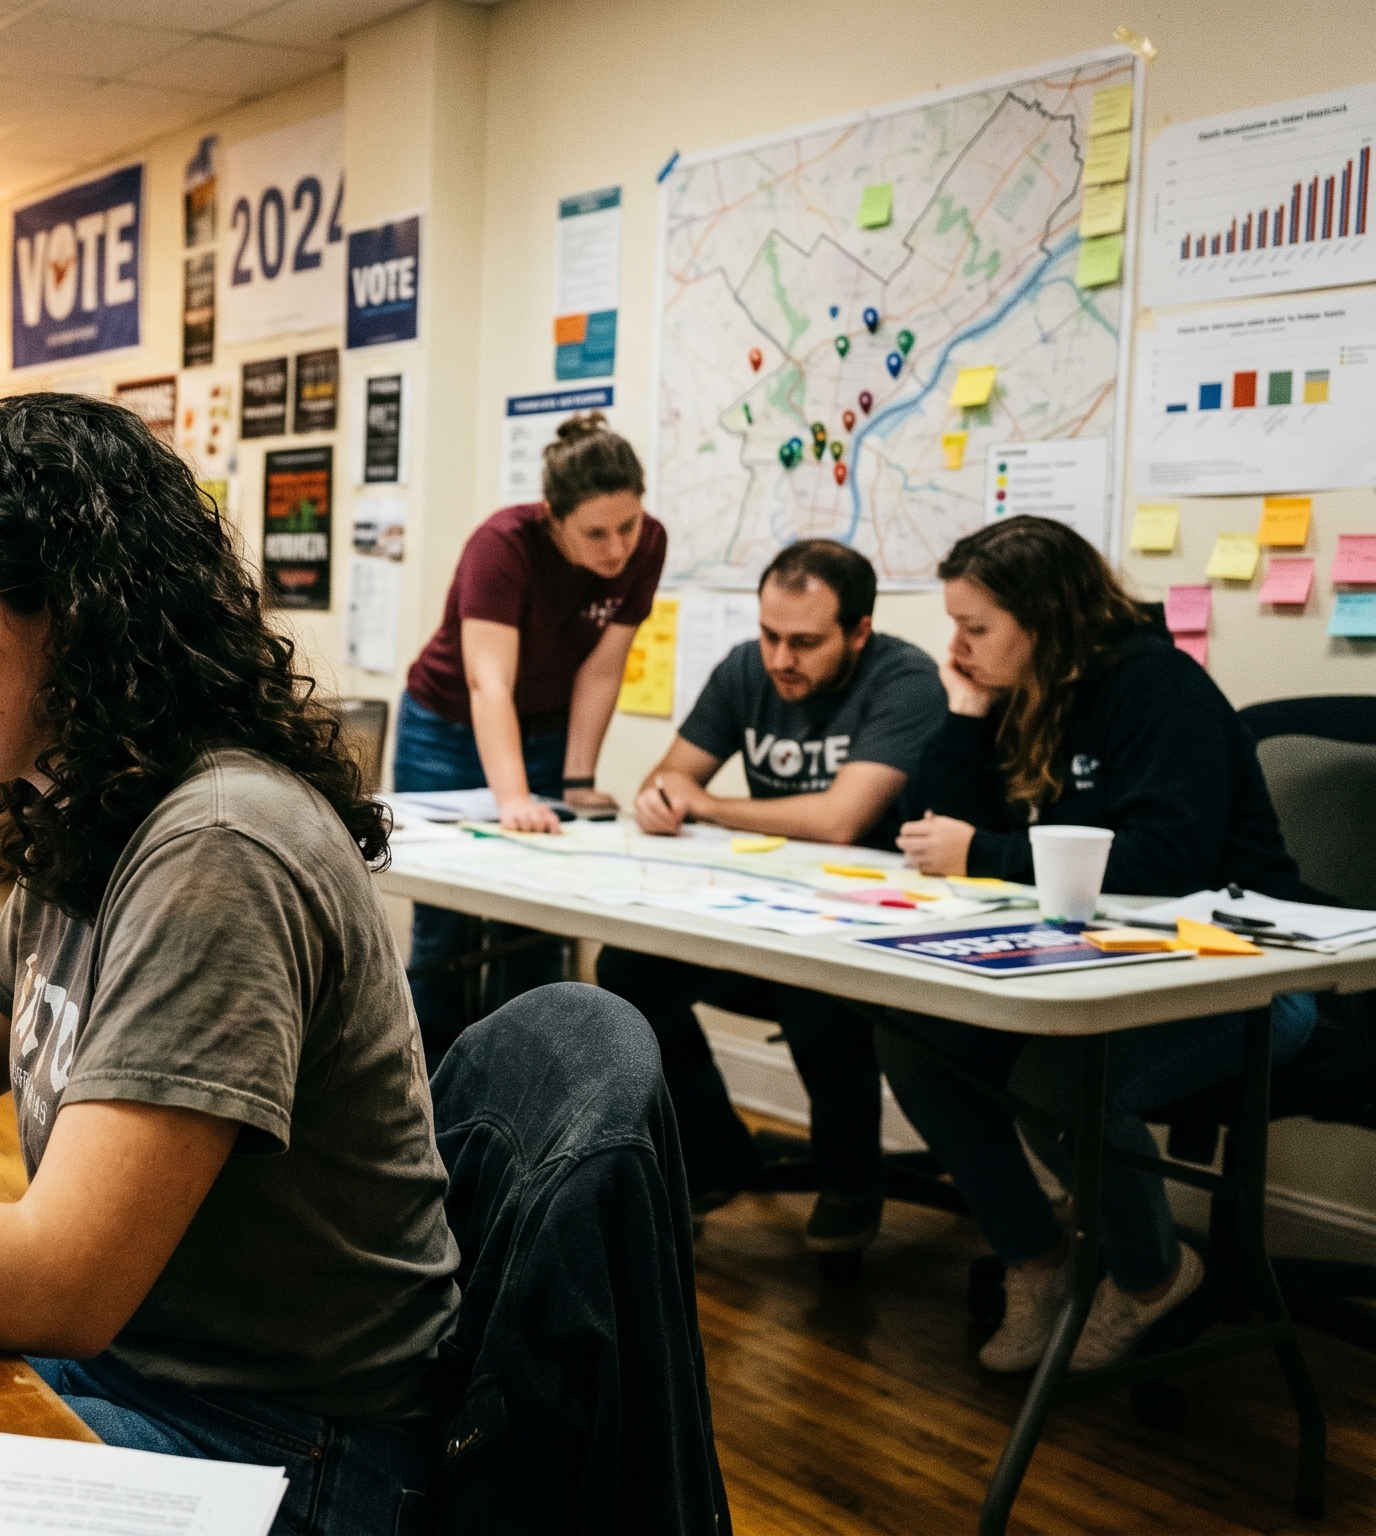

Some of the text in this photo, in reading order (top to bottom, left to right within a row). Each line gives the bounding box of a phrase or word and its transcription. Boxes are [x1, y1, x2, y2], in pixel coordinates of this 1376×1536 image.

[16, 202, 136, 328] VOTE
[352, 256, 416, 309] VOTE
[744, 727, 851, 778] VOTE
